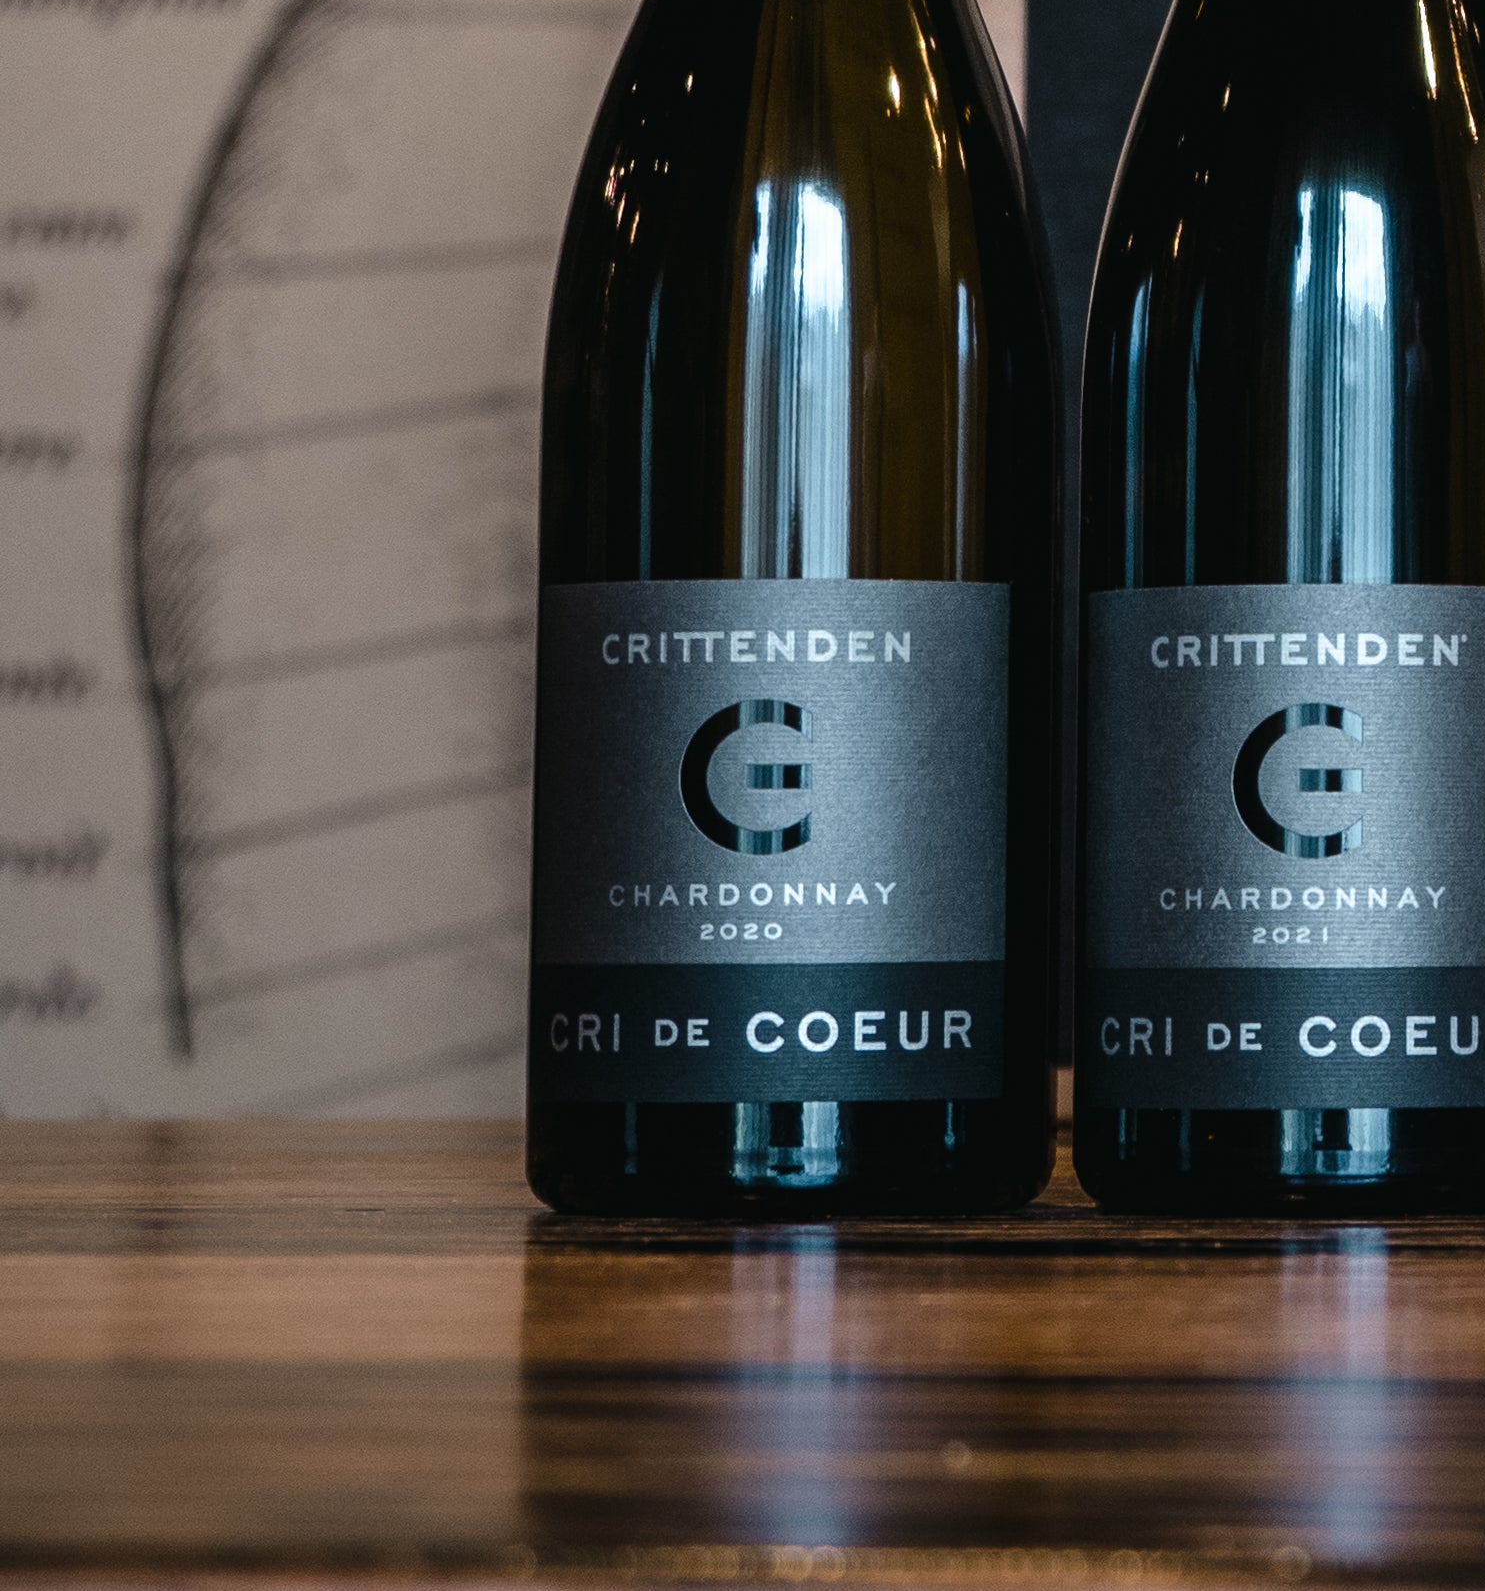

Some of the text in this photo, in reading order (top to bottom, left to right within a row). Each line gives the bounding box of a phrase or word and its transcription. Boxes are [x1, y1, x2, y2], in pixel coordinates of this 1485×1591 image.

[602, 629, 911, 665] CRITTENDEN
[607, 881, 897, 907] CHARDONNAY
[1159, 885, 1446, 911] CHARDONNAY
[699, 921, 784, 941] 2020
[1251, 925, 1329, 945] 2021
[551, 1010, 971, 1054] CRI DE COEUR
[1101, 1016, 1173, 1057] CRI
[1207, 1022, 1263, 1052] DE
